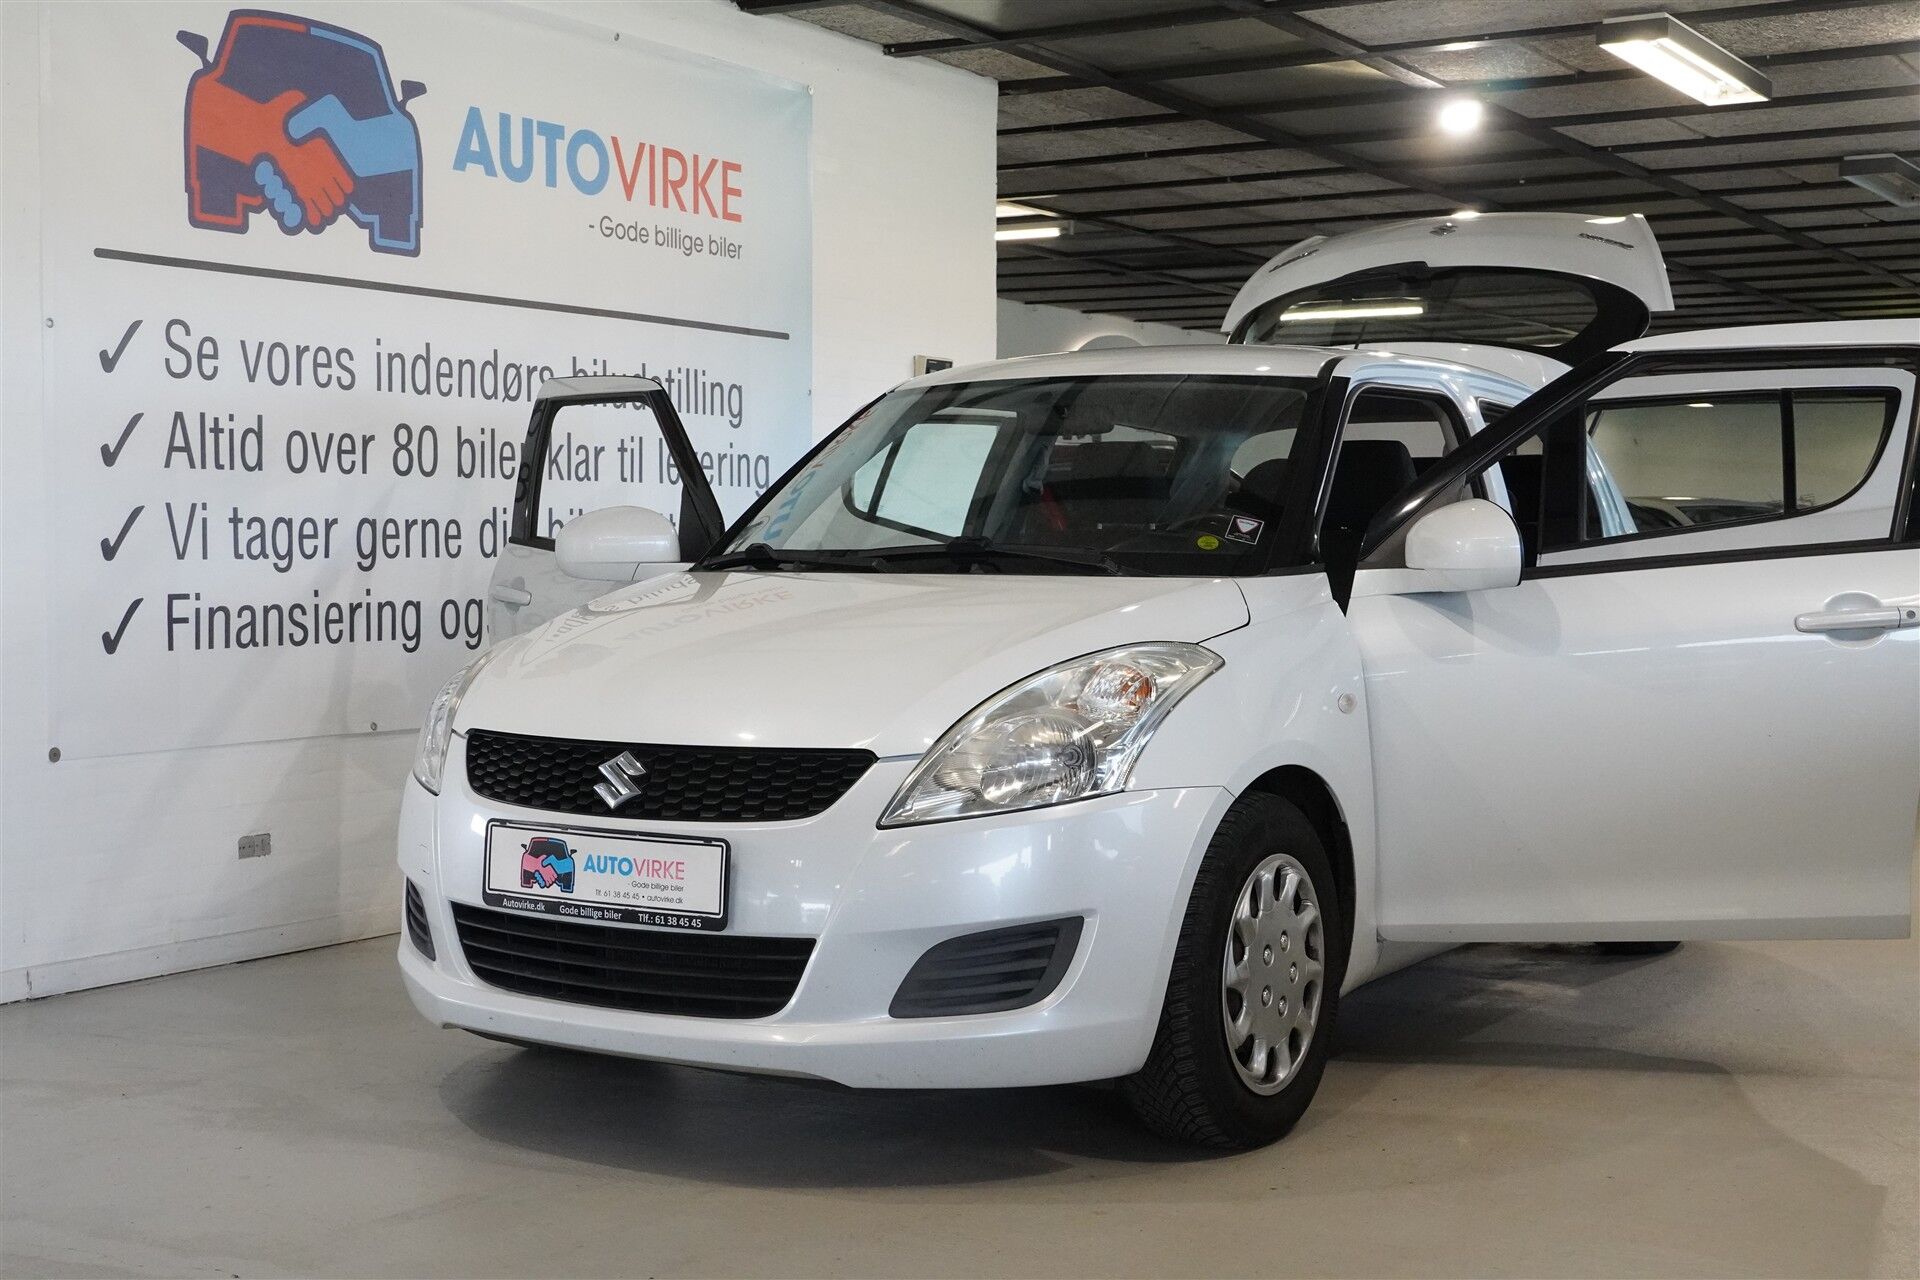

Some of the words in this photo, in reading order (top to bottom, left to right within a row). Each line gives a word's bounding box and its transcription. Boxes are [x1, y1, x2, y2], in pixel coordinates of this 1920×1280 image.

[452, 106, 743, 223] AUTOVIRKE
[600, 215, 649, 244] Gode
[655, 224, 704, 257] billige
[708, 234, 743, 260] biler
[164, 318, 219, 381] Se
[240, 339, 356, 391] vores
[163, 411, 264, 472] Altid
[285, 429, 375, 475] over
[392, 422, 439, 478] 80
[457, 425, 526, 480] bile
[548, 431, 606, 482] klar
[617, 436, 643, 483] til
[658, 437, 770, 498] leering
[165, 502, 208, 560] Vi
[228, 506, 338, 574] tager
[356, 516, 462, 573] gerne
[479, 506, 508, 559] di
[166, 589, 421, 653] Finansiering
[440, 598, 483, 650] og
[583, 854, 685, 881] AUTOVIRKE
[603, 889, 611, 897] 61
[622, 891, 631, 899] 45
[632, 892, 640, 900] 45
[631, 880, 650, 888] Gode
[651, 881, 669, 892] billige
[670, 884, 684, 892] biler
[502, 898, 546, 912] Autovirke.dk
[559, 905, 579, 915] Gode
[580, 906, 602, 919] billige
[604, 909, 622, 920] biler
[655, 914, 665, 925] 61
[667, 916, 678, 926] 38
[679, 917, 689, 927] 45
[691, 918, 702, 928] 45
